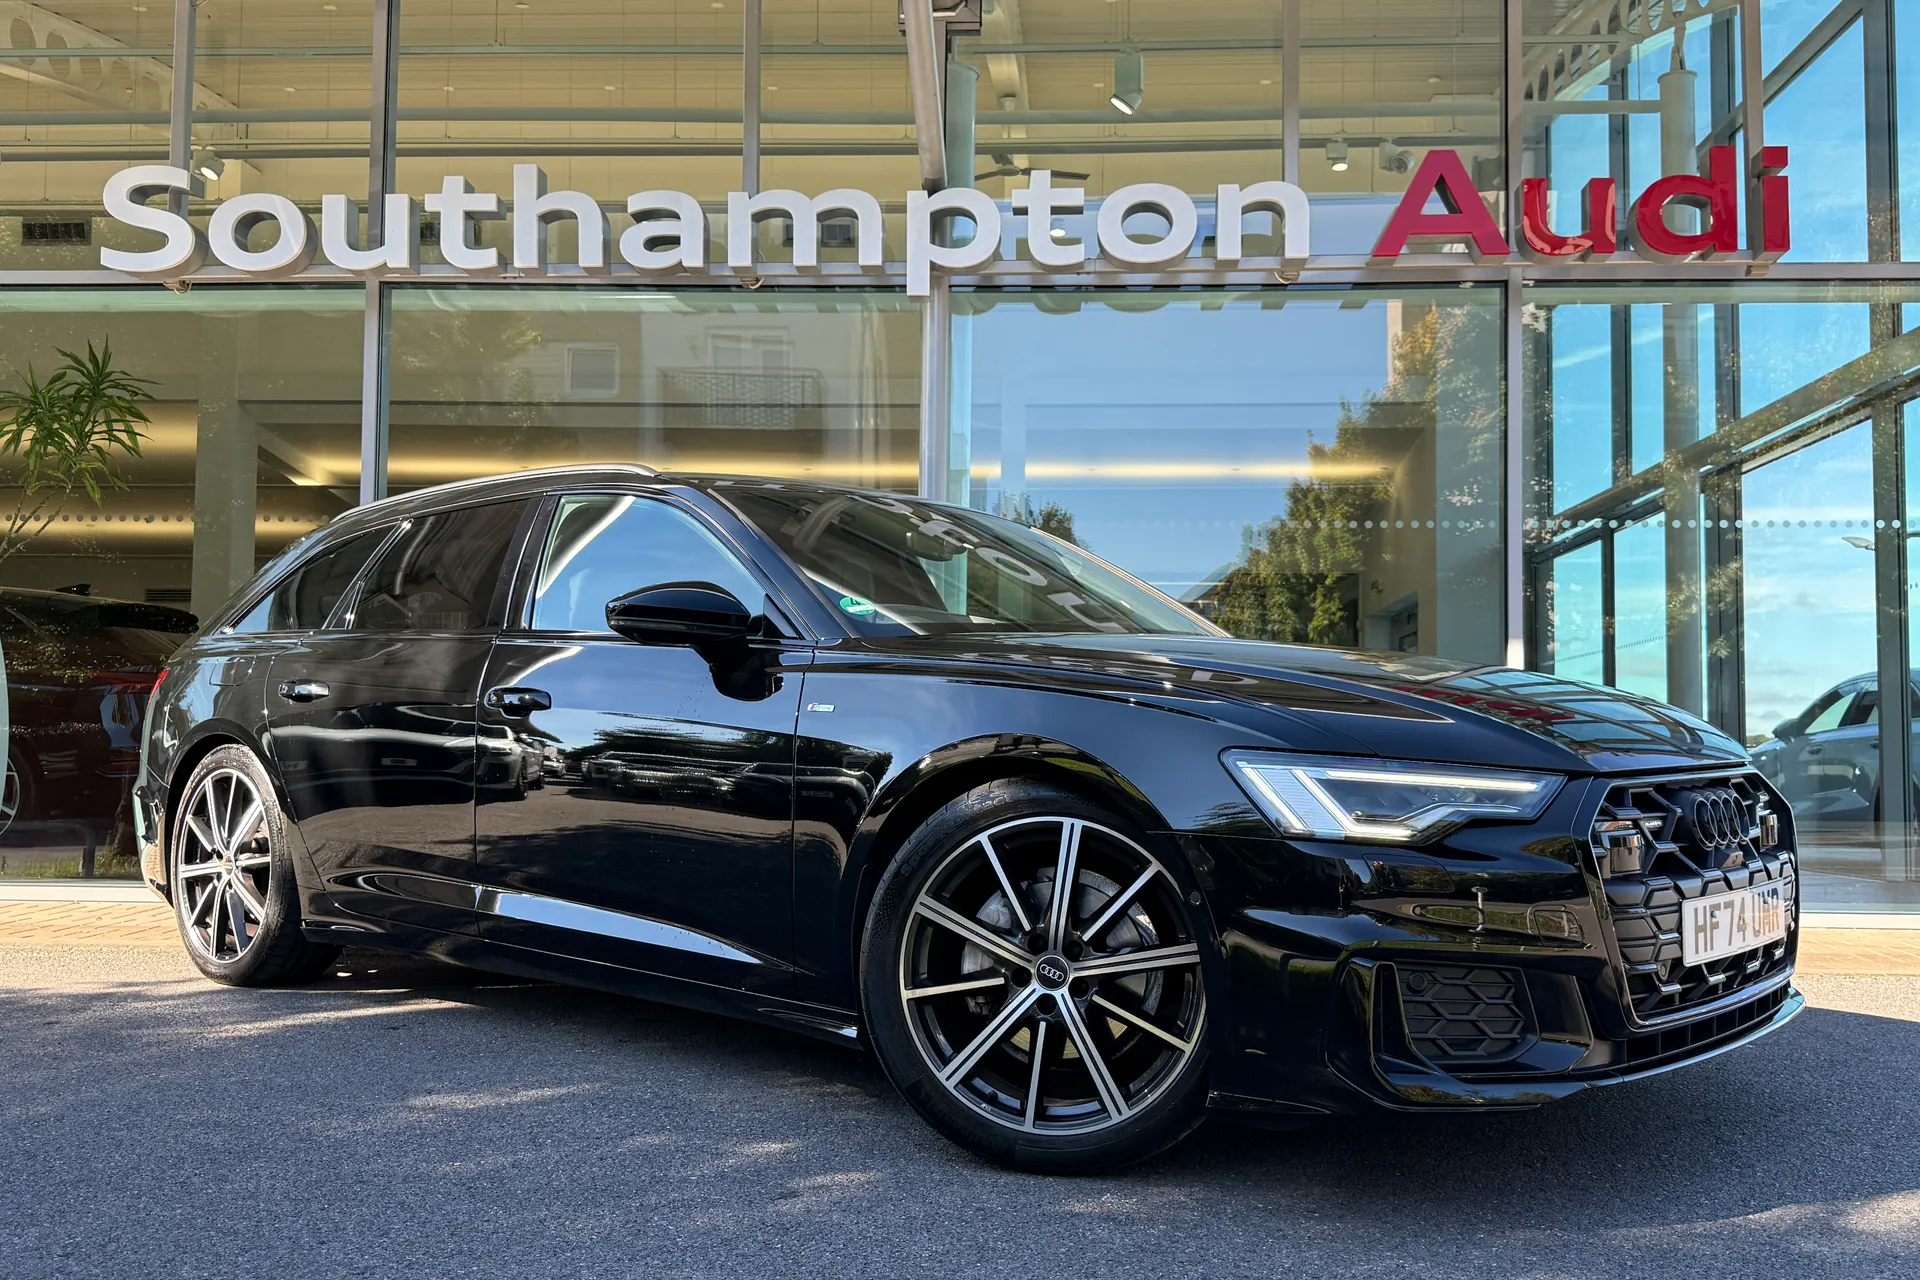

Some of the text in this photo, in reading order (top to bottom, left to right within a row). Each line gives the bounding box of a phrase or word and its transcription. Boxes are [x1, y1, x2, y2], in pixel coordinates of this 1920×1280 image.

[99, 145, 1789, 297] Southampton Audi
[1693, 896, 1747, 955] HF74
